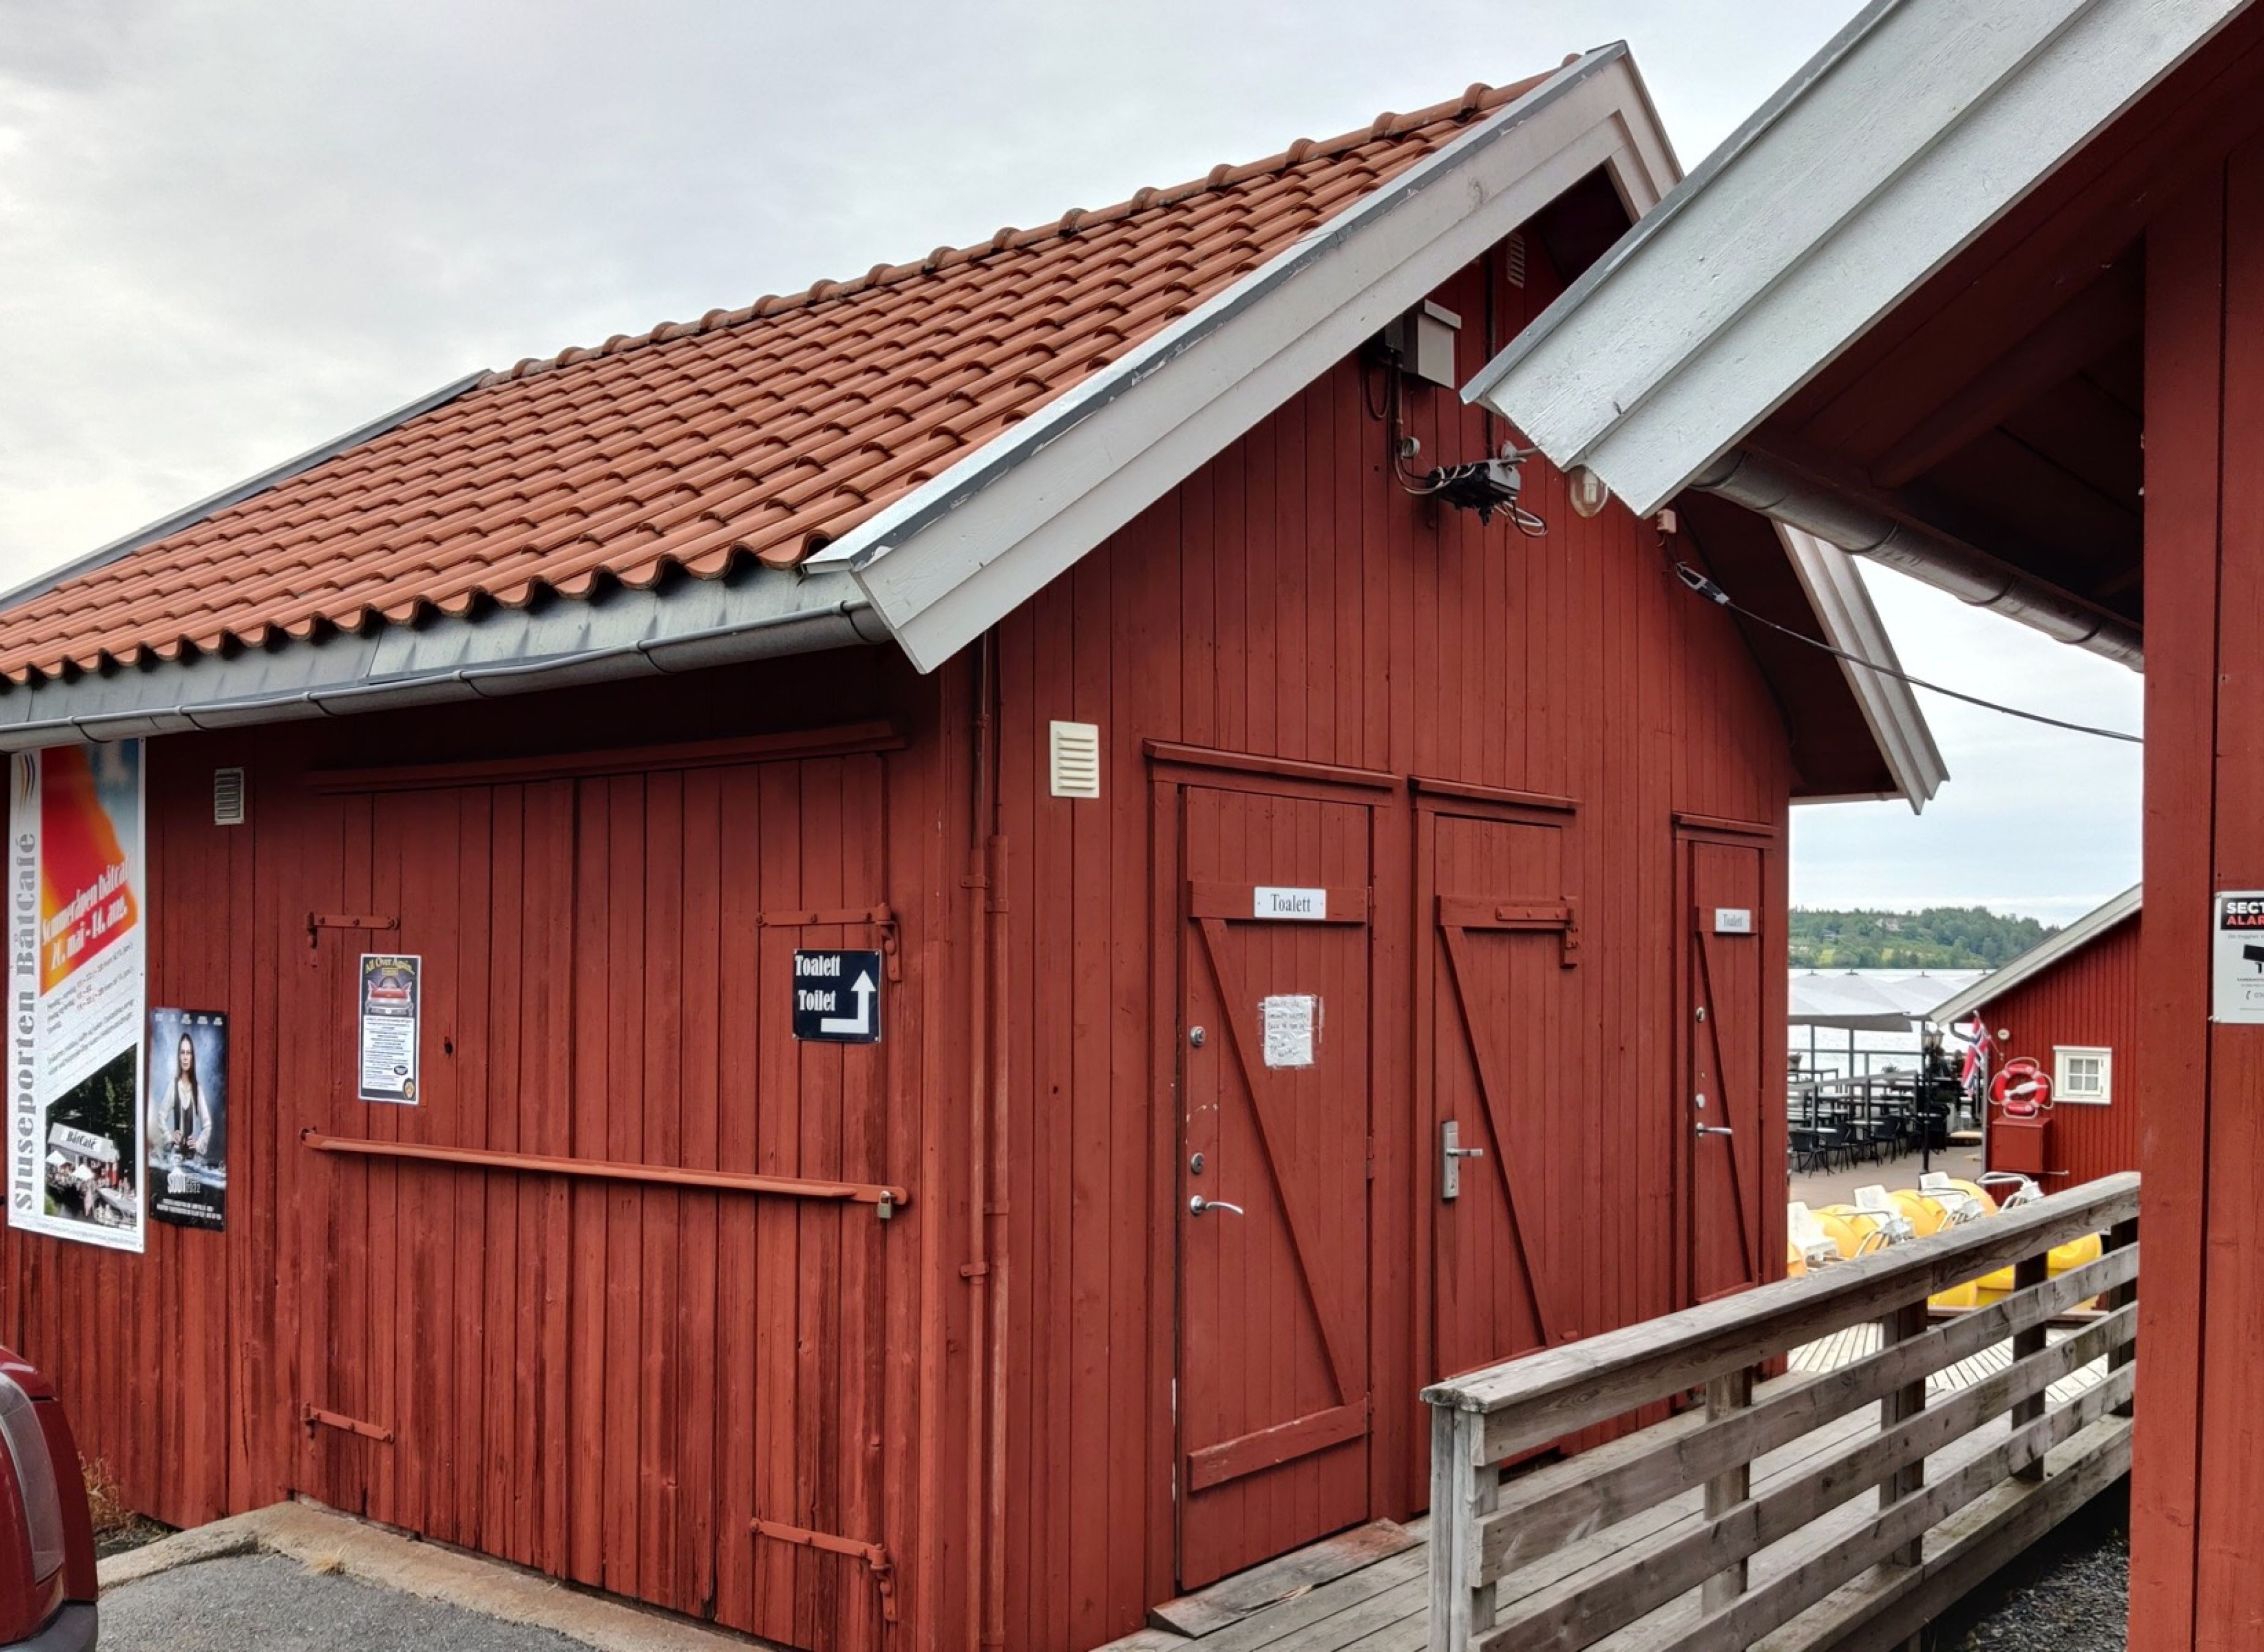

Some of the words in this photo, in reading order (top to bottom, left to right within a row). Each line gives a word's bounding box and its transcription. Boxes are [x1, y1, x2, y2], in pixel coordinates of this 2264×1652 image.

[14, 833, 35, 975] BåtCafé
[1270, 893, 1311, 912] Toalett
[795, 955, 841, 977] Toalett
[798, 989, 836, 1011] Toilet
[15, 991, 37, 1211] Sluseporten
